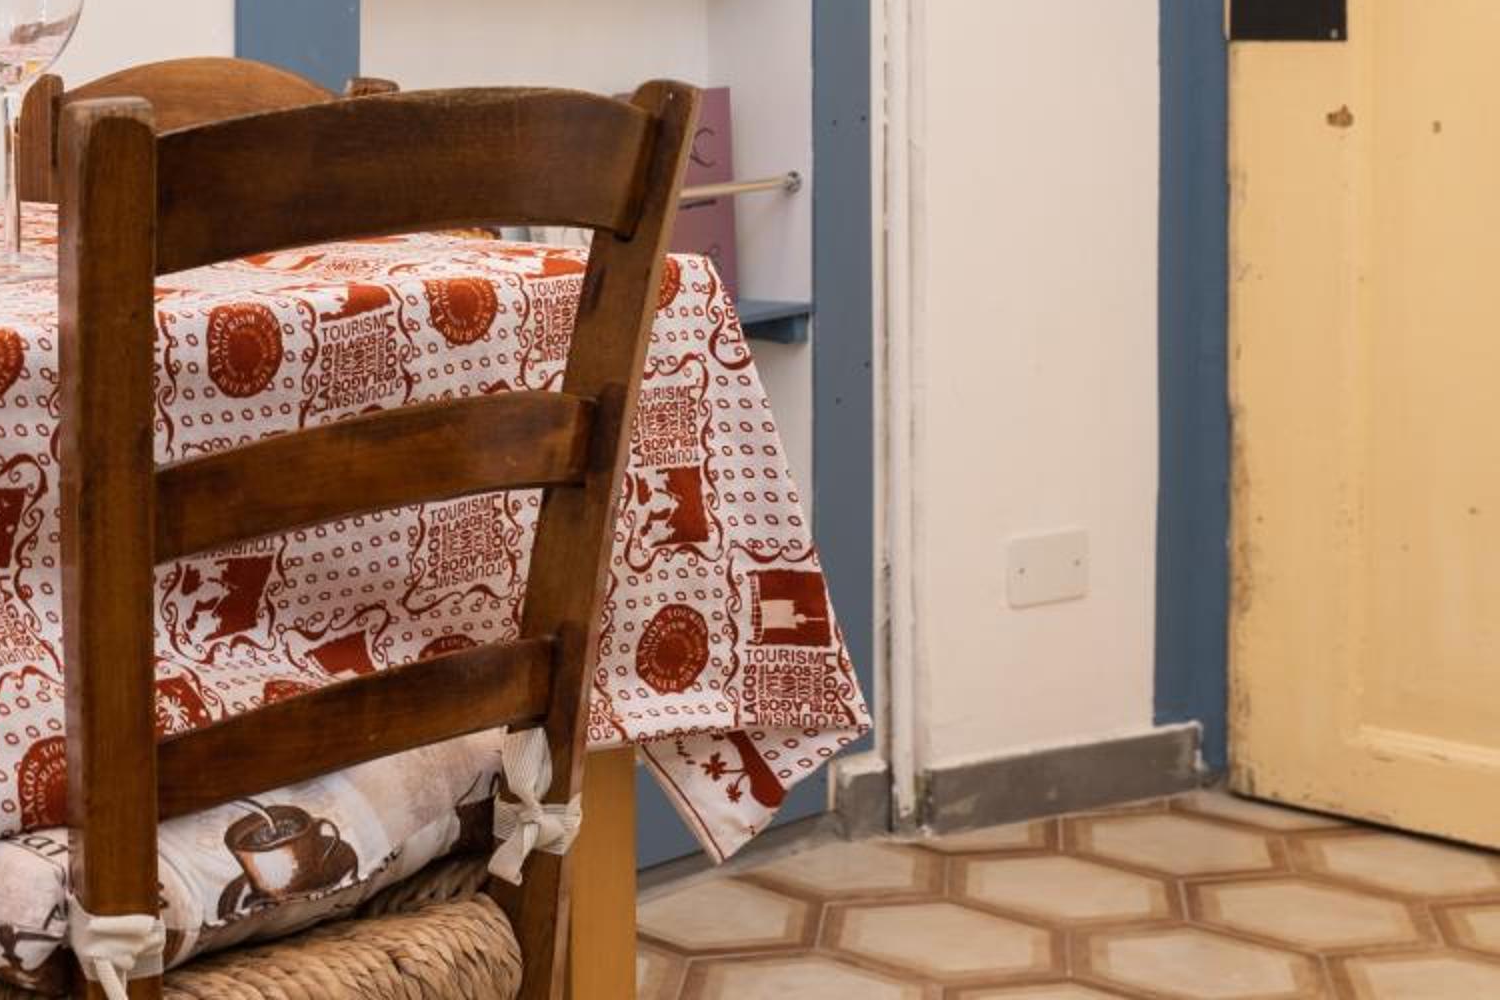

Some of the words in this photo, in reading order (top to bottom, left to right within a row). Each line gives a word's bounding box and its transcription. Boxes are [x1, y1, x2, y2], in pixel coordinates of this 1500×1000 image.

[321, 315, 387, 342] TOURISM
[431, 496, 491, 524] TOURISM
[744, 648, 822, 665] TOURISM
[743, 664, 758, 725] LAGOS
[823, 652, 838, 714] LAGOS
